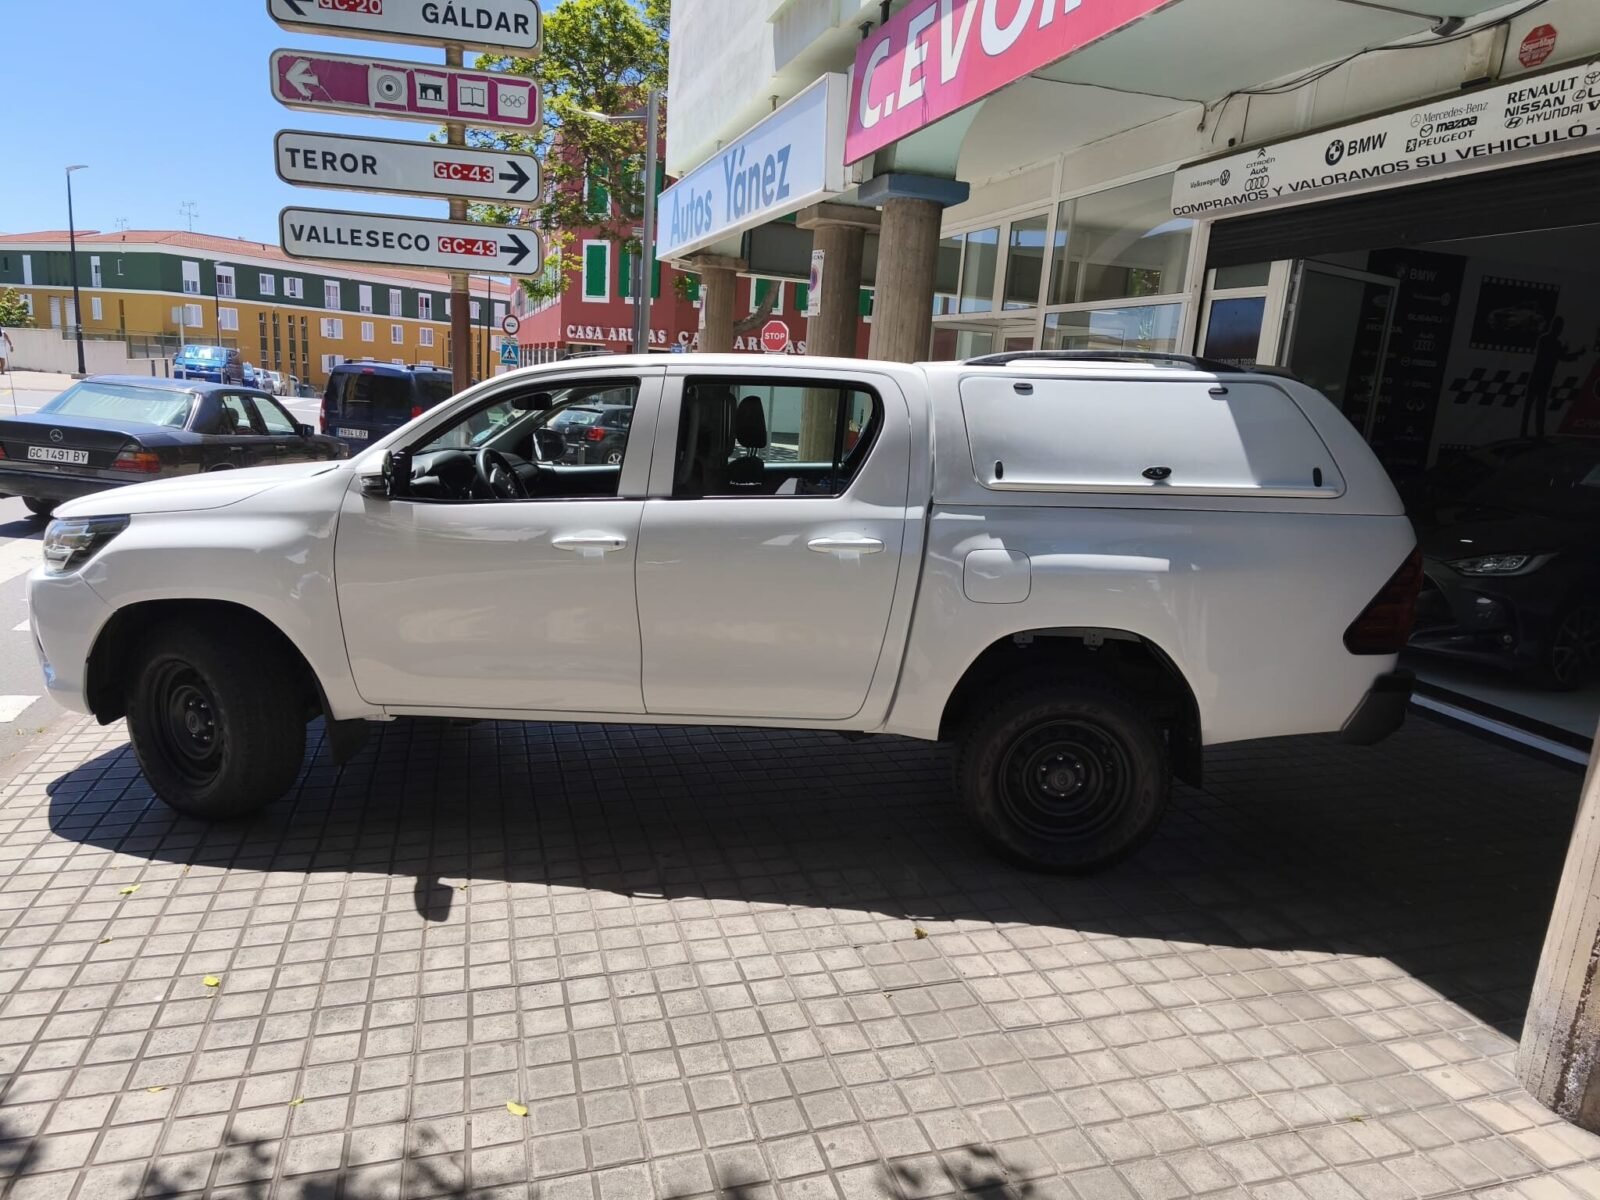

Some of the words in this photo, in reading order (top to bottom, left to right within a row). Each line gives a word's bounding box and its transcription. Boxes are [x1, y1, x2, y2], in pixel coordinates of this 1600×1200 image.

[422, 1, 529, 35] GÁLDAR
[1507, 76, 1579, 104] RENAULT
[1423, 102, 1489, 124] Mercedes-Benz
[1504, 95, 1566, 118] NISSAN
[1526, 103, 1583, 124] HYUNDAI
[1347, 132, 1387, 157] BMW
[1418, 129, 1475, 148] PEUGEOT
[285, 147, 377, 175] TEROR
[1172, 189, 1269, 216] COMPRAMOS
[1272, 186, 1283, 197] Y
[1288, 160, 1410, 192] VALORAMOS
[1415, 152, 1447, 168] SU
[1456, 124, 1588, 159] VEHICULO
[1249, 166, 1269, 176] Audi
[434, 162, 494, 182] GC-43
[1190, 177, 1220, 189] Volkswagen
[671, 187, 713, 247] Autos
[723, 144, 791, 222] Yánez
[290, 223, 430, 251] VALLESECO
[438, 237, 497, 256] GC-43
[566, 325, 603, 339] CASA
[764, 332, 786, 340] STOP
[30, 448, 43, 458] GC
[45, 449, 70, 461] 1491
[73, 451, 88, 462] BY
